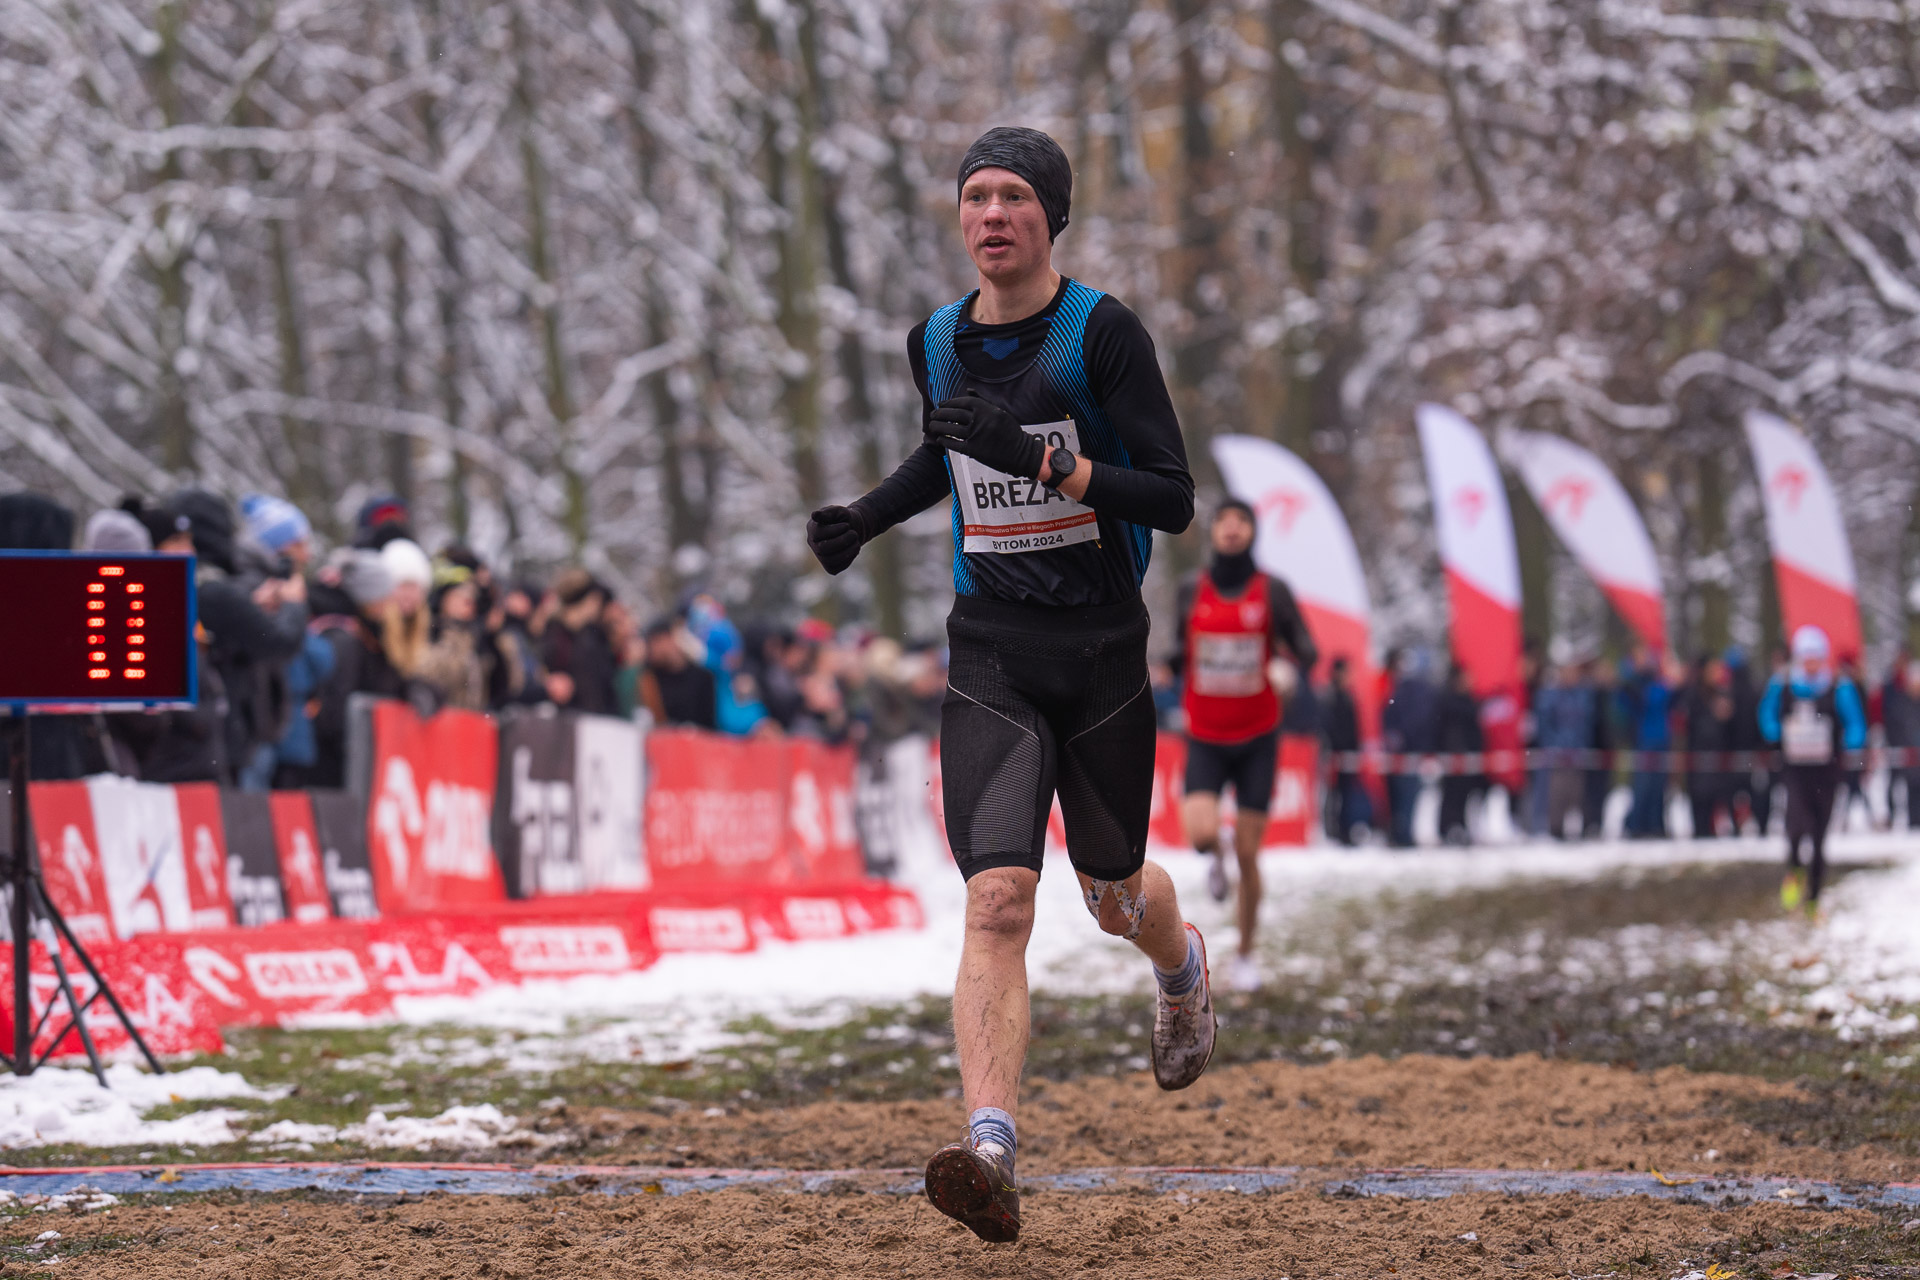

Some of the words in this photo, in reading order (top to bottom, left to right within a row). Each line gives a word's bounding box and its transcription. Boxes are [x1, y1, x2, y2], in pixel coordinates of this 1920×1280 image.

[1010, 525, 1026, 533] Polski
[1032, 523, 1054, 531] Biegach
[992, 538, 1031, 550] BYTOM
[1033, 534, 1065, 547] 2024
